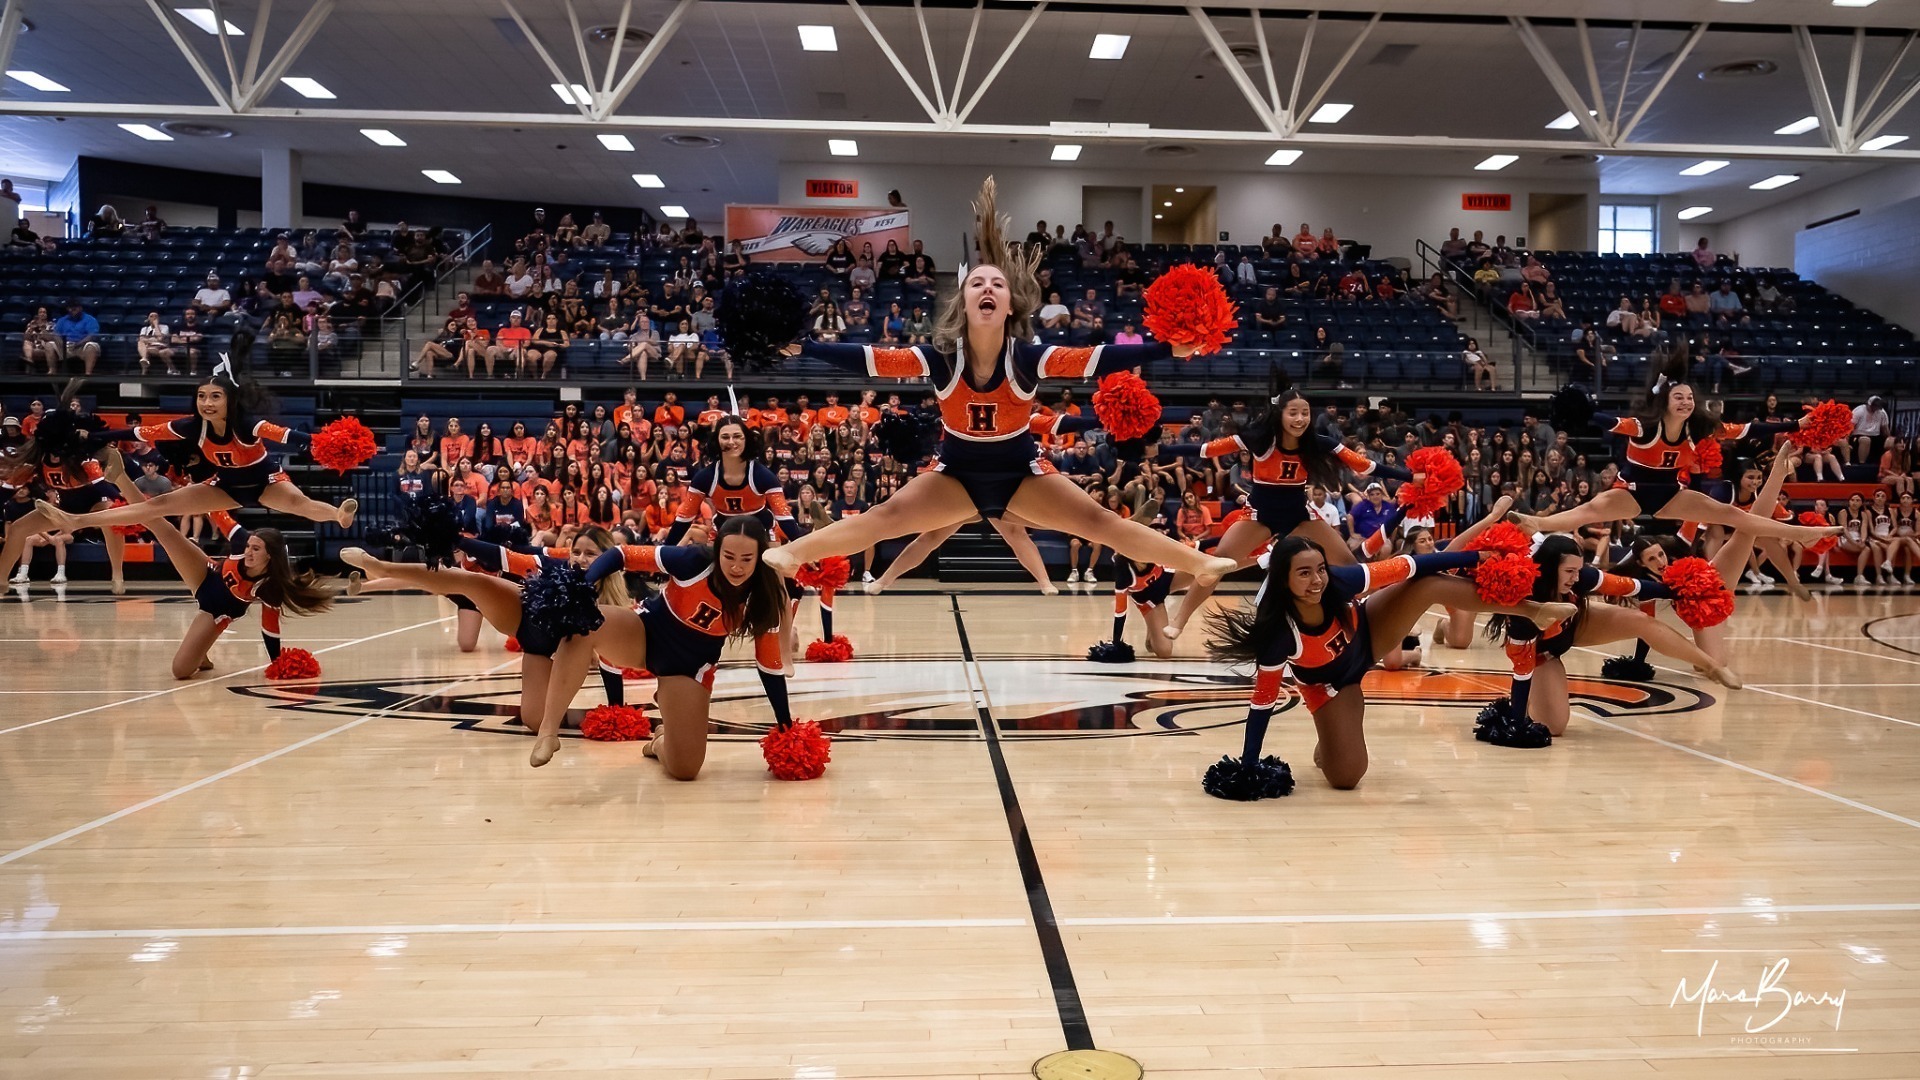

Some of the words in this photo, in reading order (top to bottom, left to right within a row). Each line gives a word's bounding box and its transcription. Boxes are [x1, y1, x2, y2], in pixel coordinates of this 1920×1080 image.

[812, 182, 853, 194] VISITOR
[1349, 284, 1364, 293] 74
[967, 403, 997, 432] H
[213, 451, 236, 467] H
[1661, 451, 1680, 468] H
[48, 471, 65, 487] H
[1279, 461, 1301, 480] H
[725, 497, 743, 514] H
[687, 601, 722, 629] H
[1324, 630, 1350, 661] H
